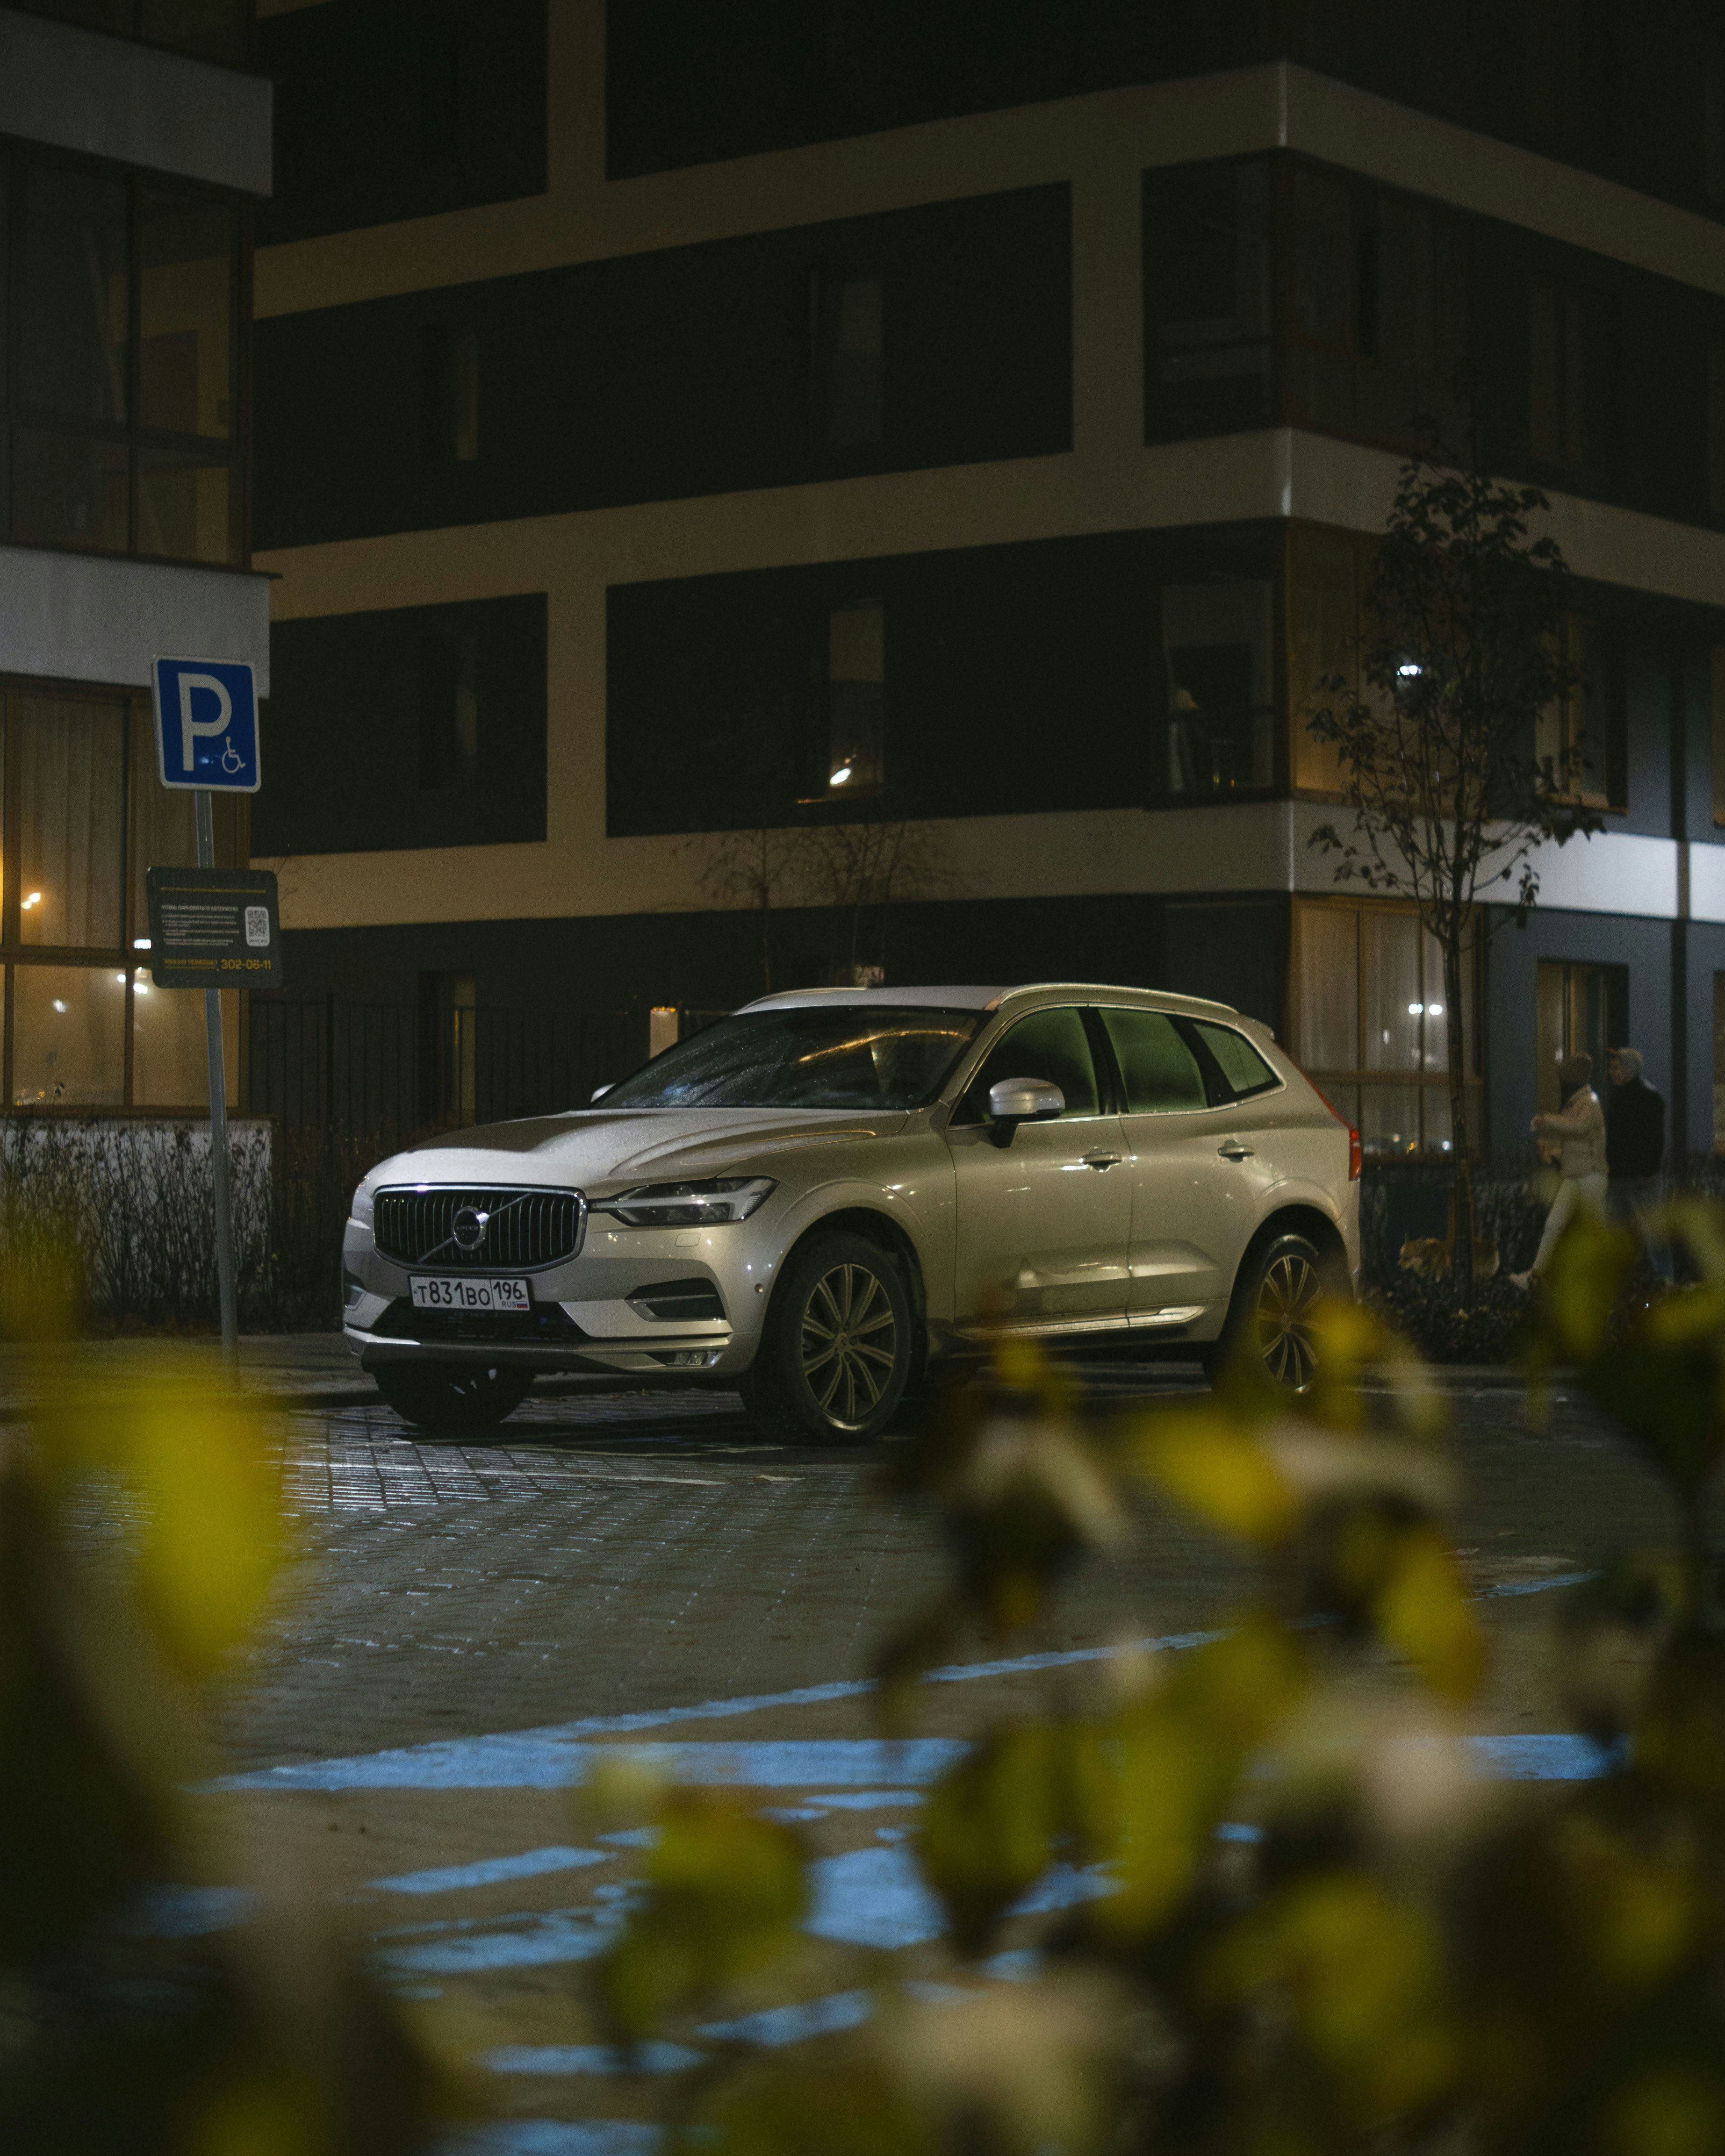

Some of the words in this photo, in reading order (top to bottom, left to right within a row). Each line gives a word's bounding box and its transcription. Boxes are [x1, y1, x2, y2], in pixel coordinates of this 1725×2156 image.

[178, 673, 232, 771] P
[221, 959, 271, 970] 302-06-11
[493, 1281, 522, 1300] 196
